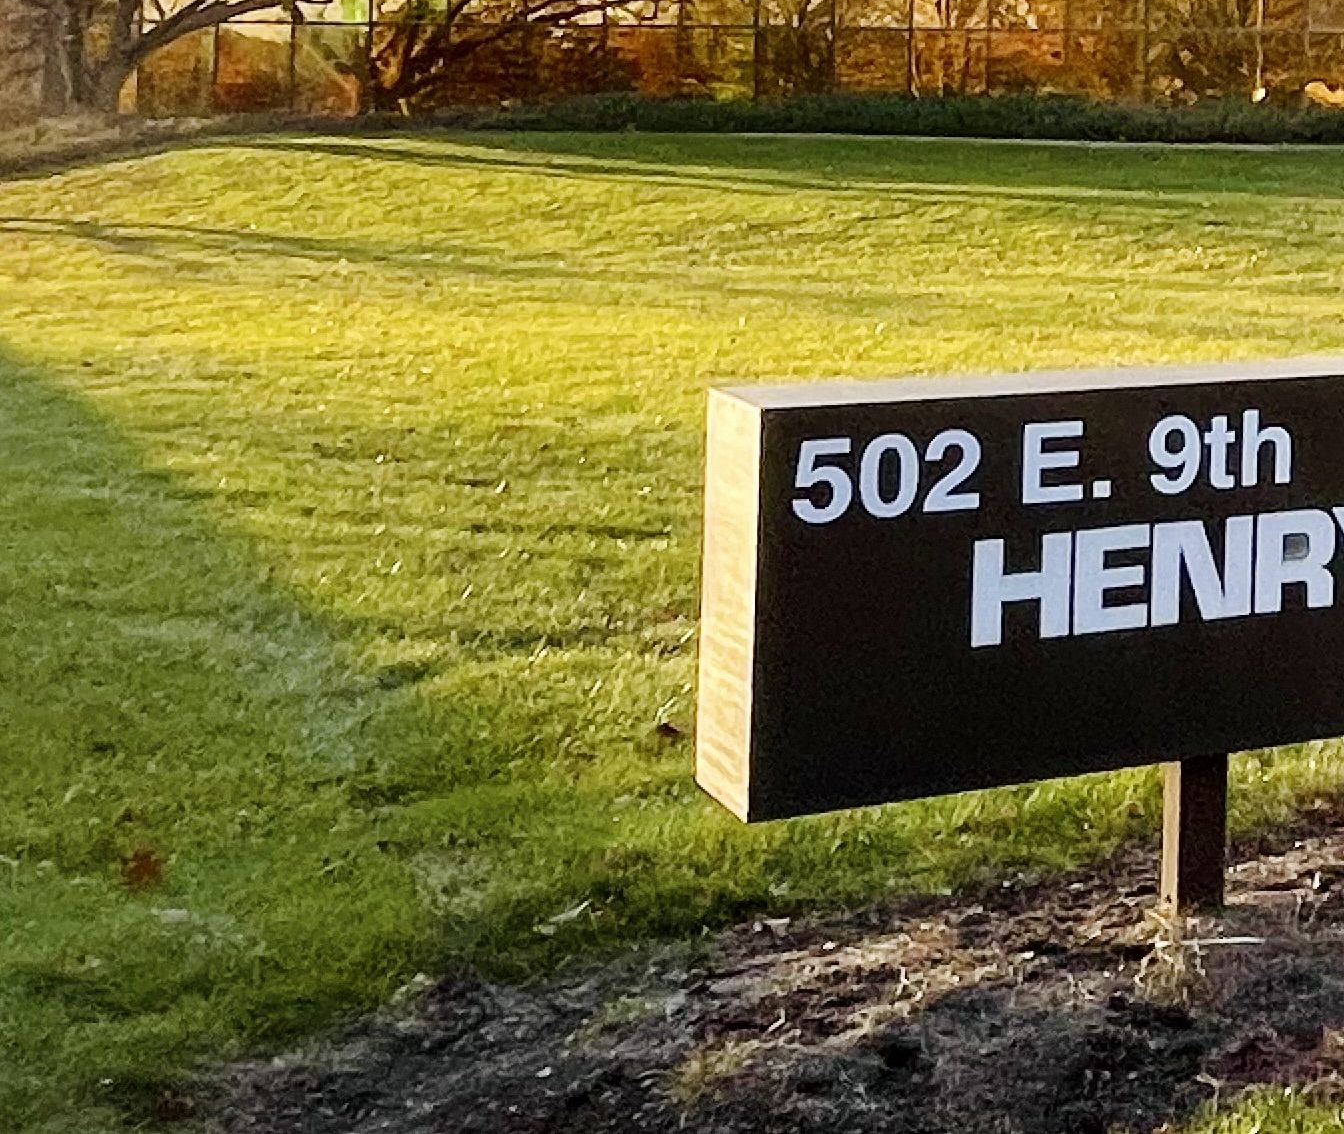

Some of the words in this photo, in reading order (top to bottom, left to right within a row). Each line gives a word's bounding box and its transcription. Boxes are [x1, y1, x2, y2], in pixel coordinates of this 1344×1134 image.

[792, 428, 982, 524] 502
[1022, 420, 1112, 504] E.
[1148, 408, 1292, 494] 9th
